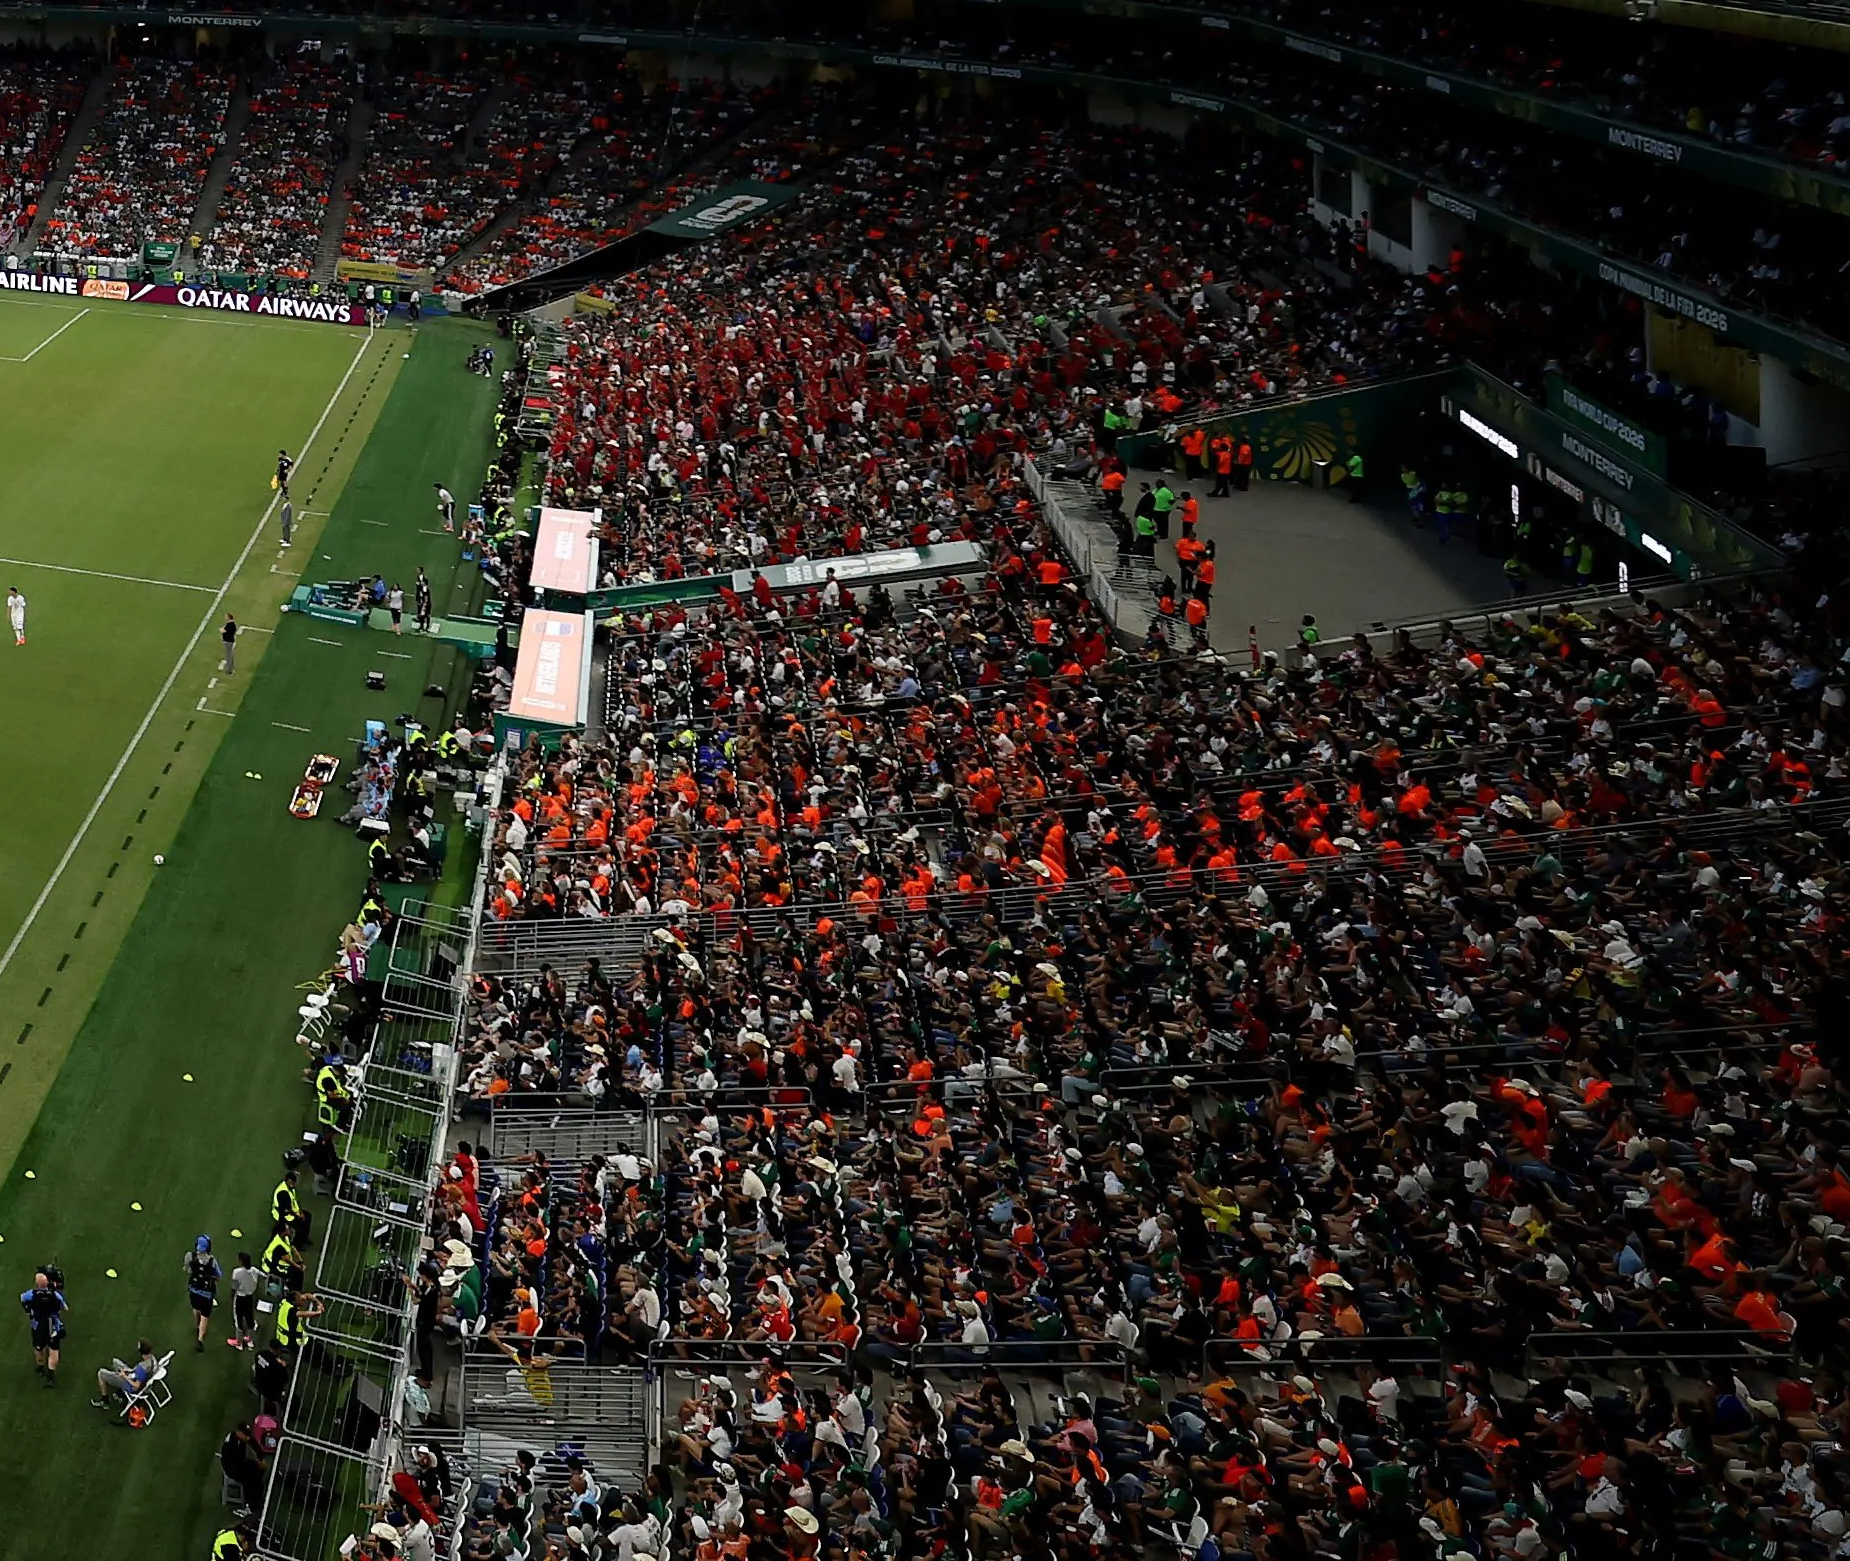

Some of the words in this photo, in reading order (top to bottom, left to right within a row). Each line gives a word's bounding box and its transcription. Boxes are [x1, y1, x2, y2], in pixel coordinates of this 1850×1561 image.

[168, 16, 262, 27] MONTERREY
[1609, 126, 1682, 163] MONTERREY
[177, 287, 250, 312] QATAR
[259, 295, 351, 324] AIRWAYS
[1697, 302, 1728, 332] 2026
[1563, 433, 1634, 491] MONTERREY
